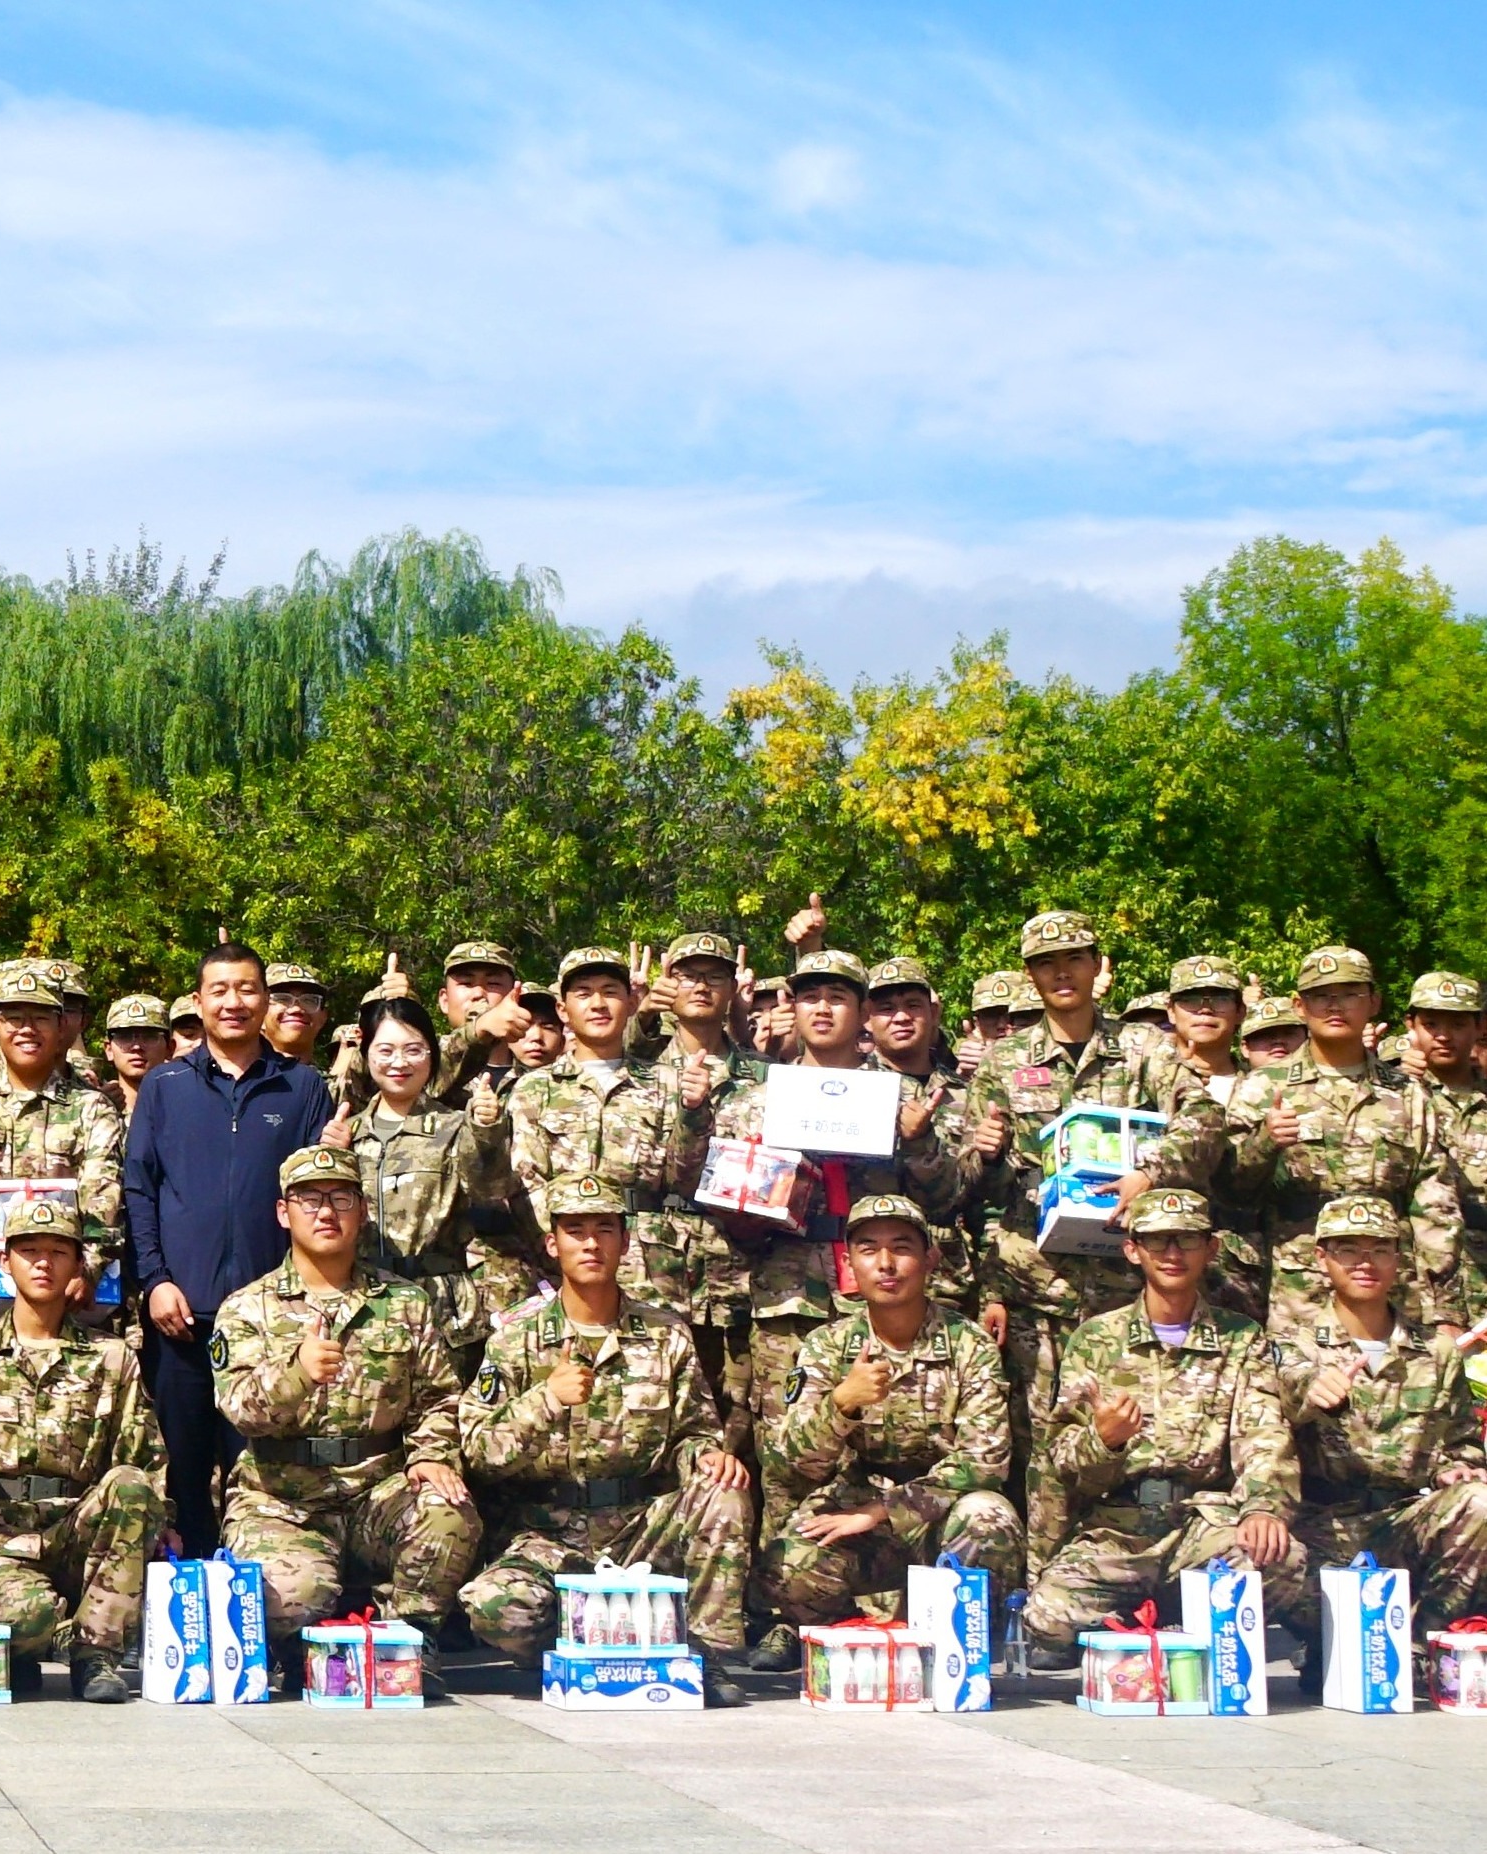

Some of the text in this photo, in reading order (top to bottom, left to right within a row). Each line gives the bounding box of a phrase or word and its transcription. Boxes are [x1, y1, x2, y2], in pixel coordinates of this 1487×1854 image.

[1021, 1071, 1043, 1083] 2-1
[182, 1591, 200, 1655] 牛奶饮品
[240, 1592, 259, 1656] 牛奶饮品
[965, 1600, 983, 1665] 牛奶饮品
[1219, 1620, 1239, 1687] 牛奶饮品
[1369, 1619, 1388, 1685] 牛奶饮品
[595, 1666, 658, 1683] 牛奶饮品
